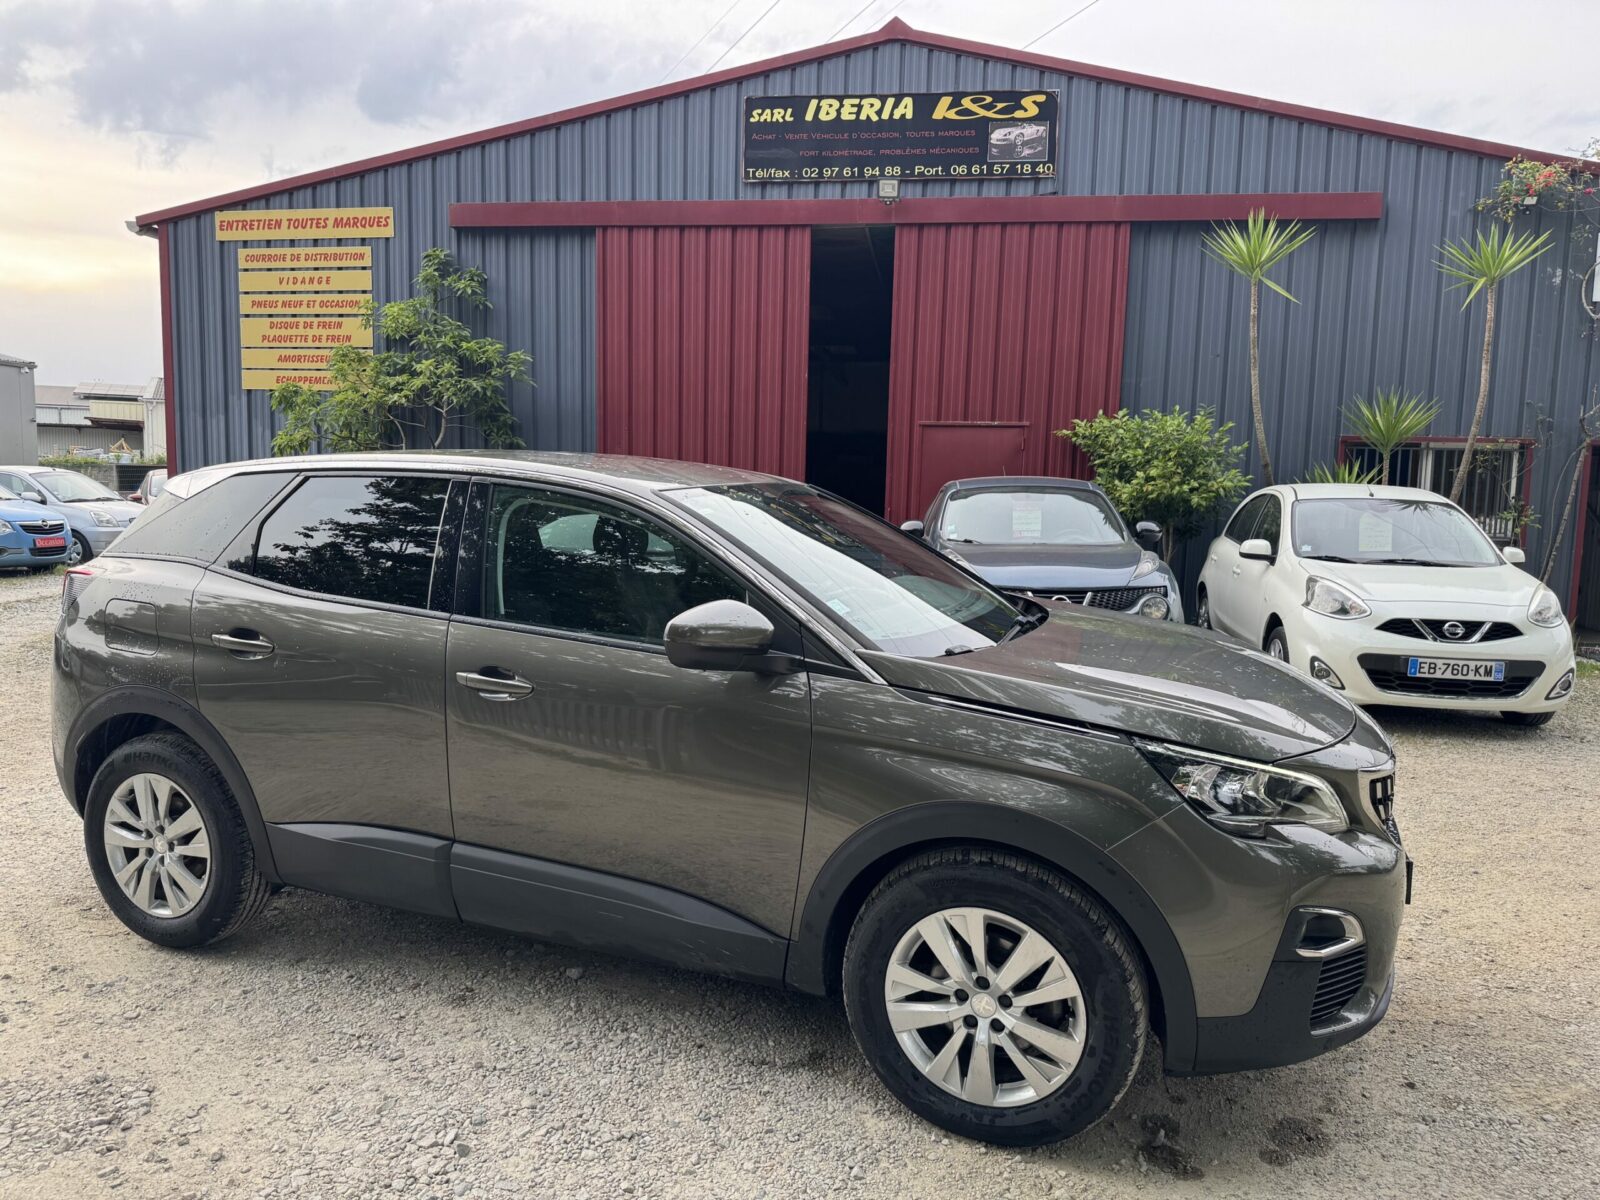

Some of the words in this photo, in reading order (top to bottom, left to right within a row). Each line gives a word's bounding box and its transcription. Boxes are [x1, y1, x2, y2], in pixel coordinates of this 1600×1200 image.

[750, 108, 794, 123] SARL
[804, 96, 913, 122] IBERIA
[784, 132, 808, 140] VENTE
[747, 168, 790, 178] Tél/fax
[802, 168, 819, 178] 02
[823, 168, 839, 177] 97
[843, 167, 858, 177] 61
[864, 167, 880, 177] 94
[884, 166, 901, 176] 88
[915, 165, 945, 175] Port.
[950, 165, 967, 175] 06
[971, 165, 987, 174] 61
[993, 164, 1010, 174] 57
[1015, 164, 1031, 174] 18
[1035, 163, 1053, 174] 40
[219, 219, 282, 232] ENTRETIEN
[286, 217, 329, 230] TOUTES
[332, 216, 390, 229] MARQUES
[245, 253, 287, 263] COURROIE
[290, 253, 302, 262] DE
[304, 252, 365, 262] DISTRIBUTION
[251, 300, 278, 309] PNEUS
[281, 300, 304, 309] NEUF
[306, 300, 316, 309] ET
[319, 299, 361, 309] OCCASION
[269, 321, 300, 330] DISQUE
[303, 321, 314, 330] DE
[317, 320, 343, 329] FREIN
[261, 334, 309, 343] PLAQUETTE
[312, 334, 323, 343] DE
[326, 334, 352, 343] FREIN
[277, 354, 333, 363] AMORTISSEU
[36, 538, 65, 546] Occasion
[1418, 661, 1493, 678] EB-760-KM
